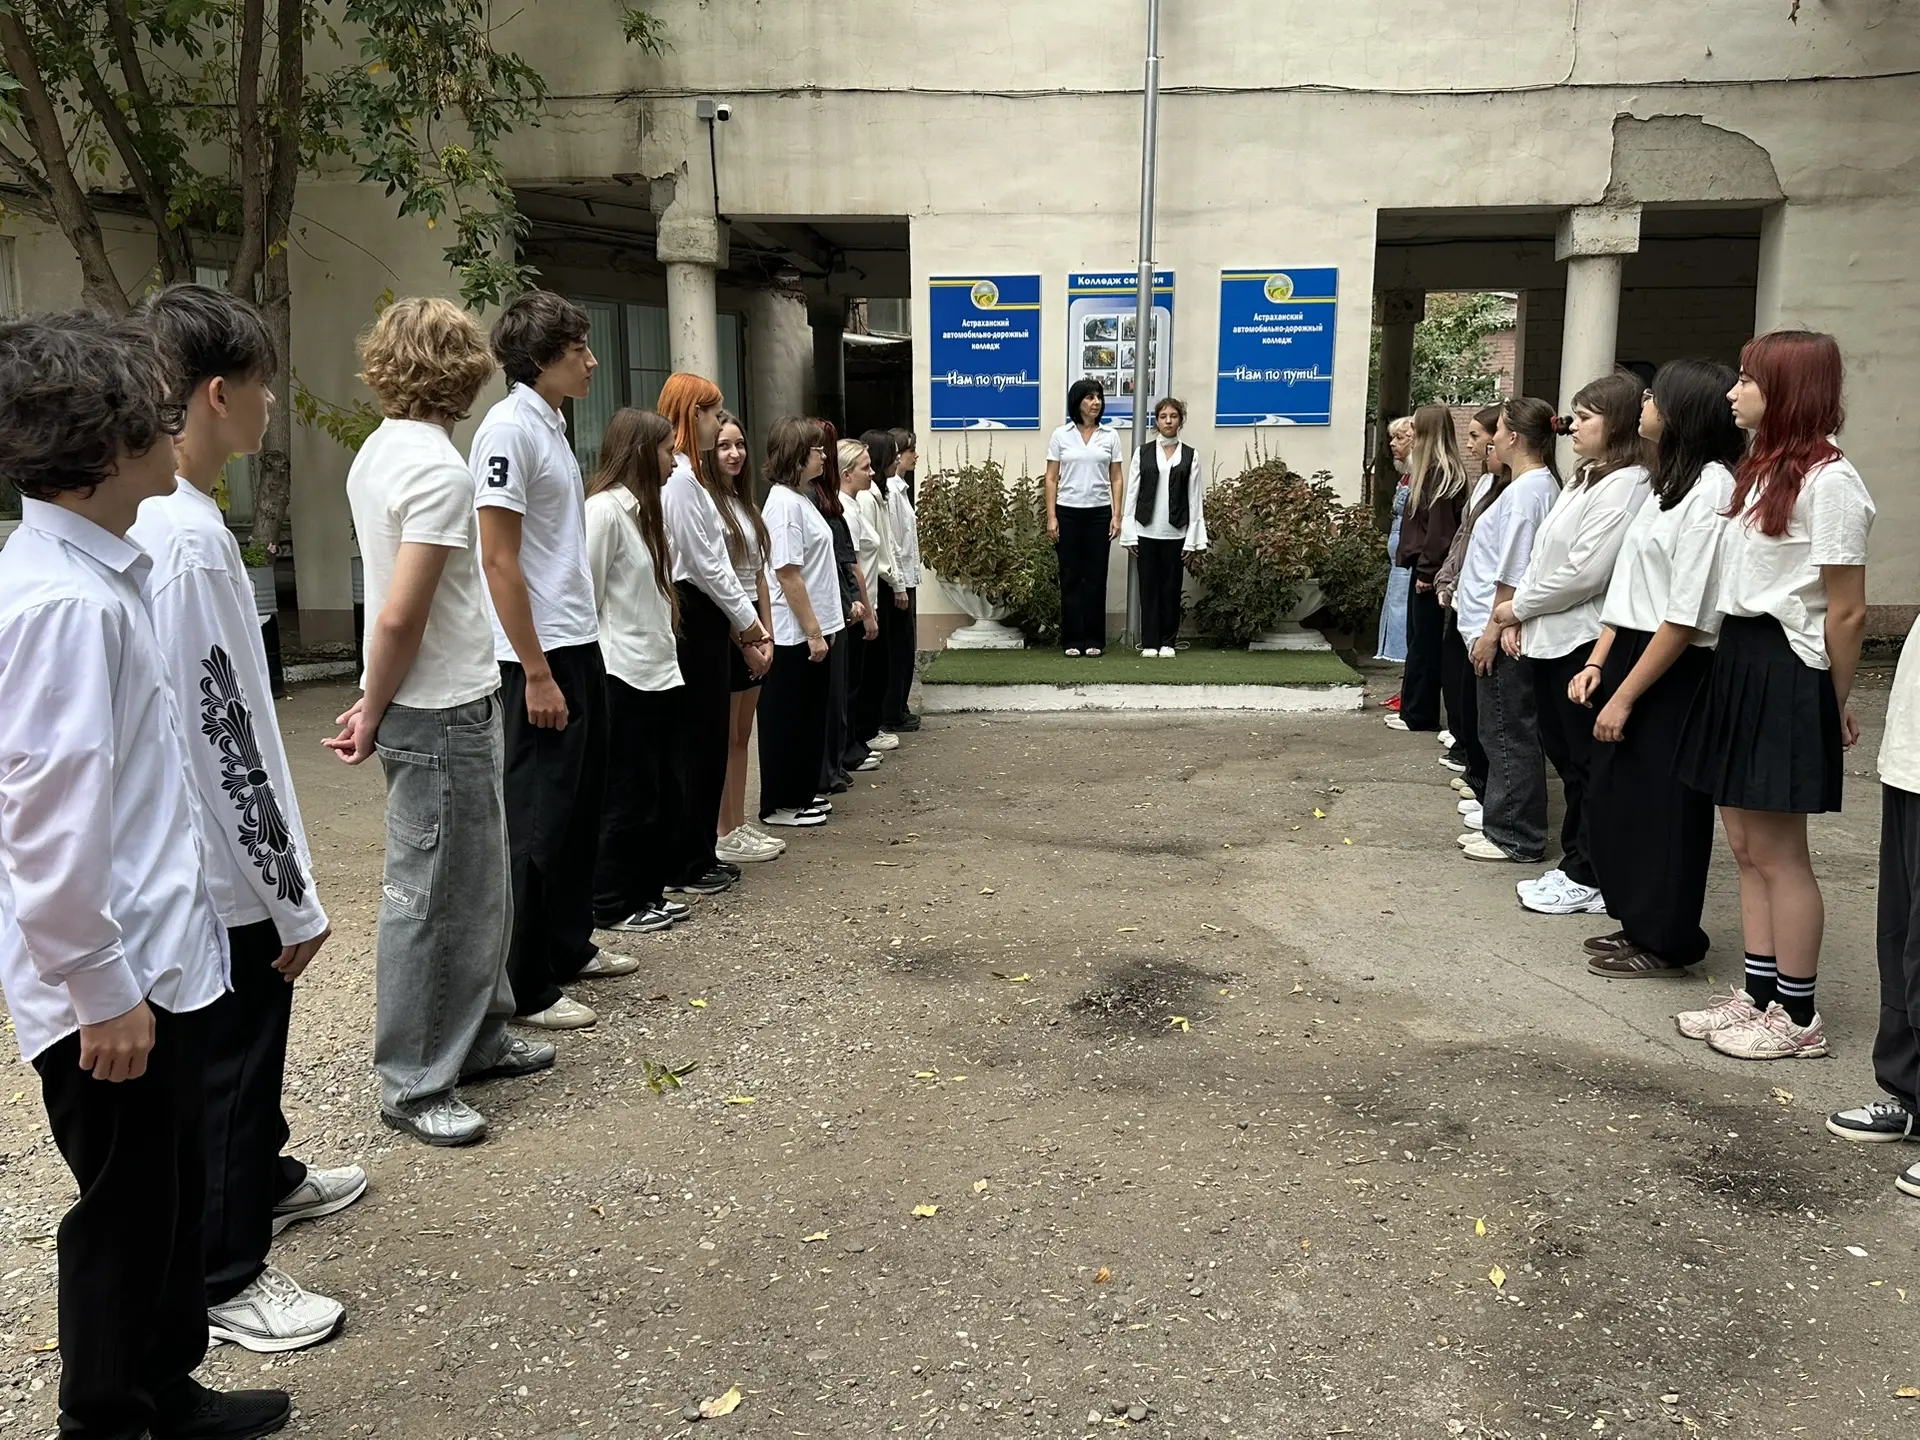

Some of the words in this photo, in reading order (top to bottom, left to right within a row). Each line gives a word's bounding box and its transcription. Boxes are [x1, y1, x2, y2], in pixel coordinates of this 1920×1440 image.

[1077, 276, 1121, 285] Колледж
[1123, 276, 1164, 285] сеня
[1253, 311, 1304, 322] Астраханский
[962, 318, 1010, 328] Астраханский
[1232, 323, 1323, 333] автомобильно-дорожный
[942, 329, 1029, 339] автомобильно-дорожный
[1262, 337, 1293, 345] колледж
[947, 371, 973, 385] Нам
[975, 375, 990, 385] по
[993, 371, 1026, 391] пути!
[1236, 366, 1262, 380] Нам
[1265, 371, 1280, 380] по
[1283, 366, 1318, 386] пути!
[488, 456, 509, 488] 3
